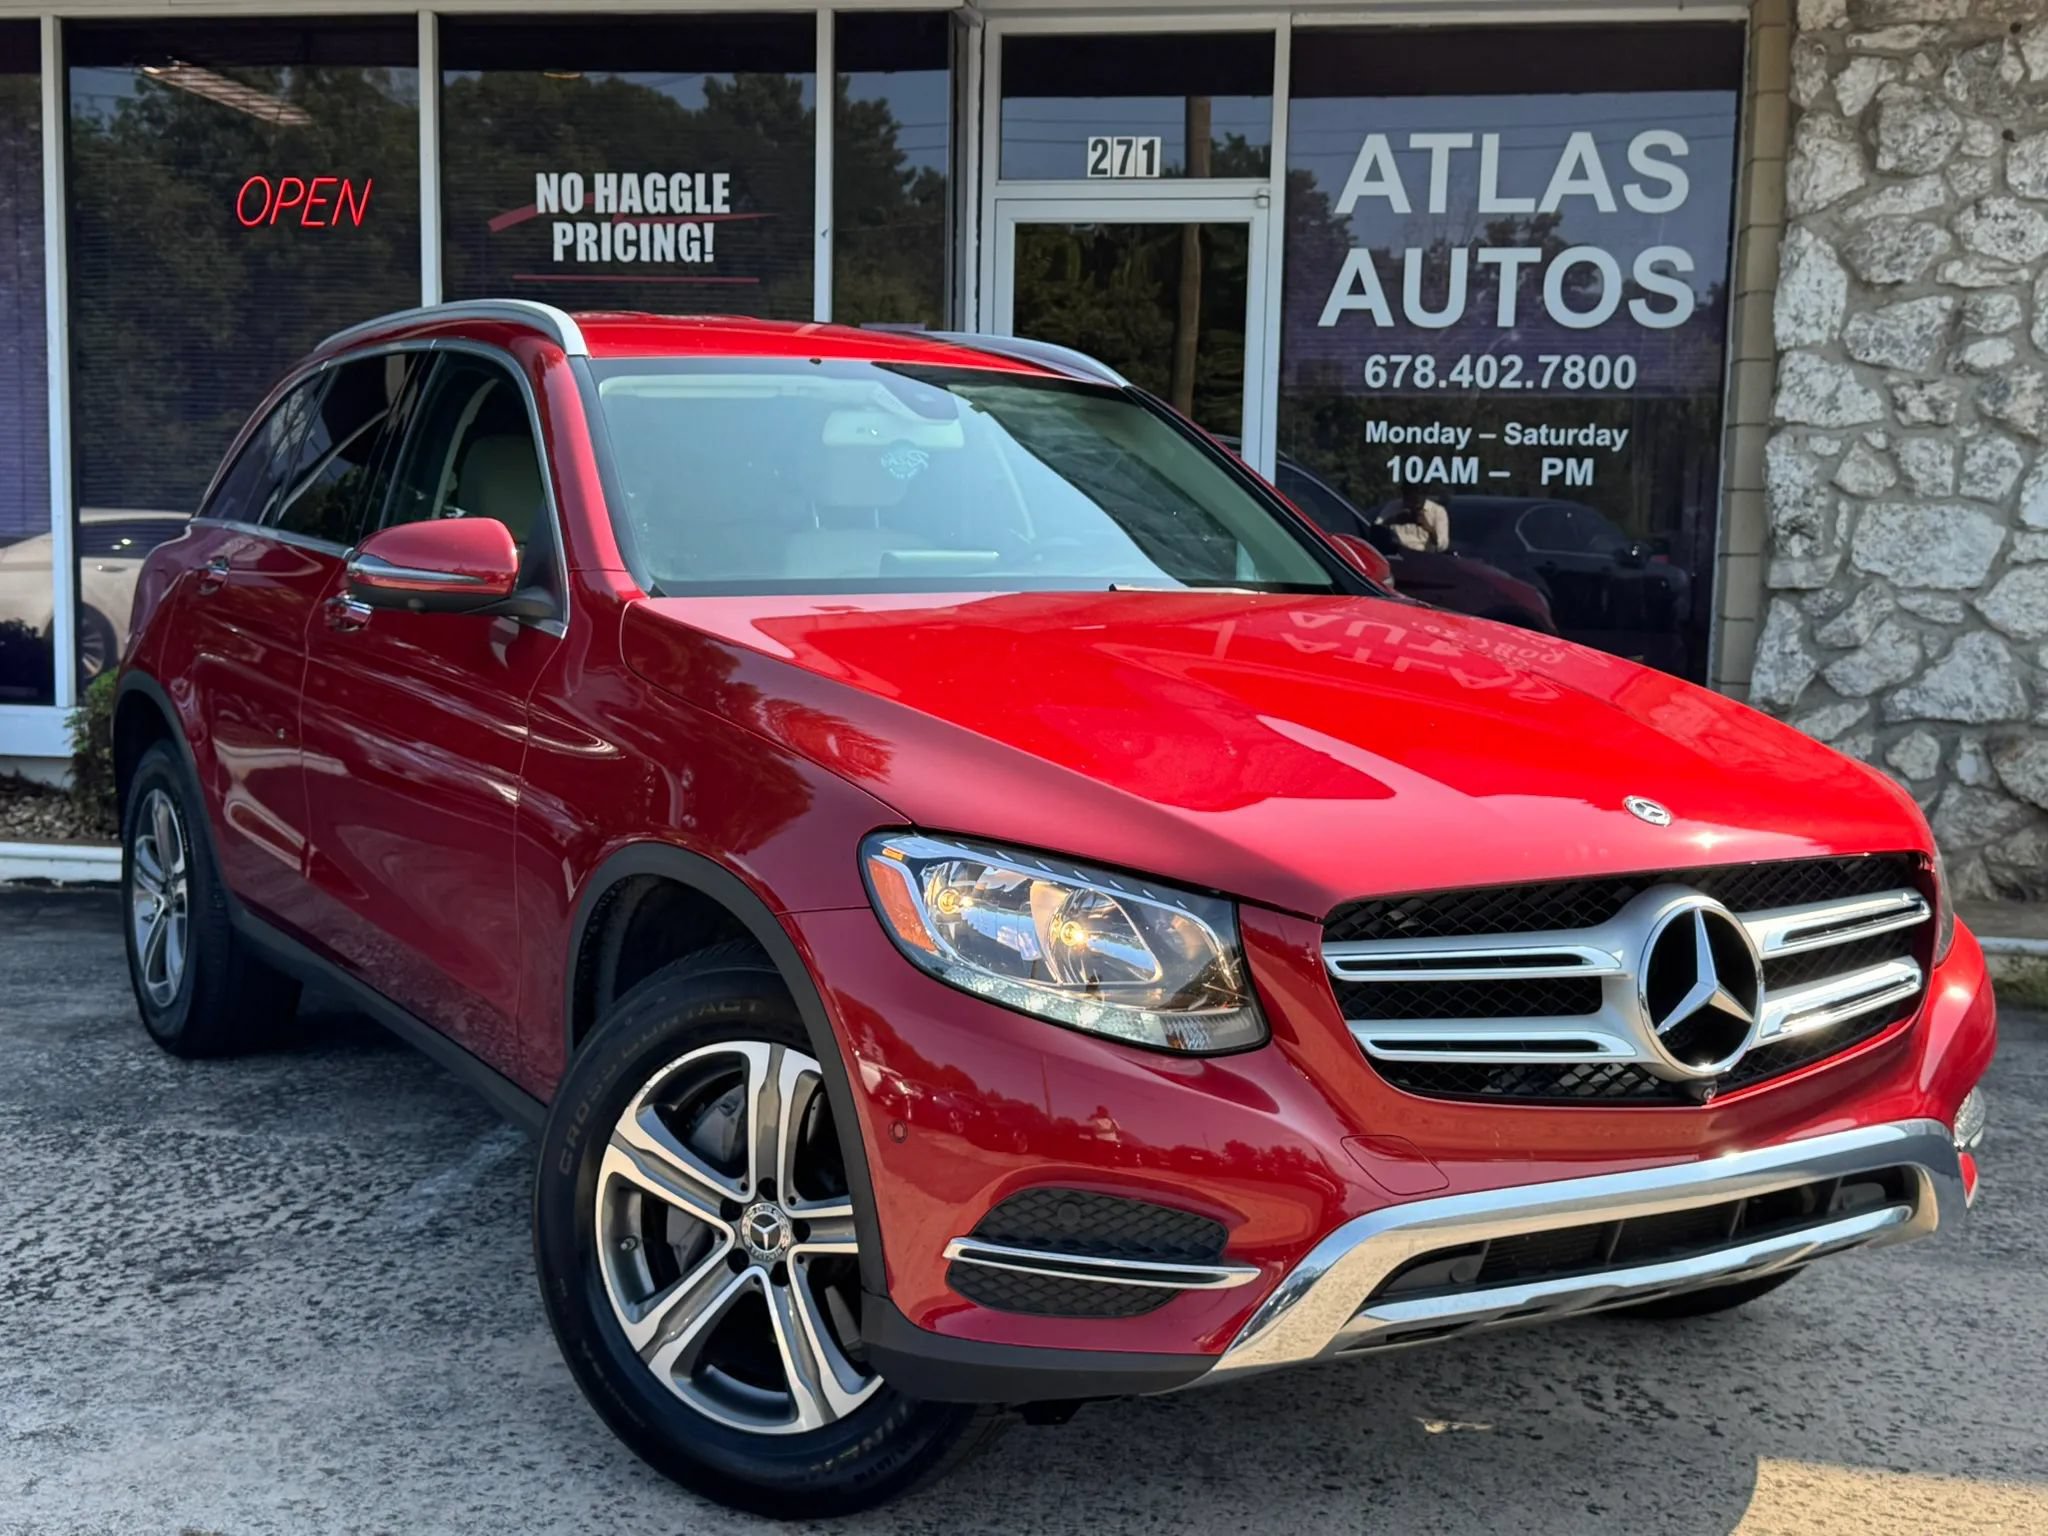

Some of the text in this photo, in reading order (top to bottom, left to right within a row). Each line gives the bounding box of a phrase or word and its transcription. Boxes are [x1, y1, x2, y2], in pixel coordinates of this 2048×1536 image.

[1090, 138, 1156, 176] 271
[1335, 131, 1690, 214] ATLAS
[235, 174, 374, 229] OPEN
[536, 172, 731, 215] NO HAGGLE
[552, 221, 715, 264] PRICING!
[1318, 246, 1695, 328] AUTOS
[1364, 354, 1637, 390] 678.402.7800
[1365, 420, 1473, 450] Monday
[1503, 421, 1630, 453] Saturday
[1386, 455, 1479, 484] 10AM
[1540, 457, 1595, 486] PM
